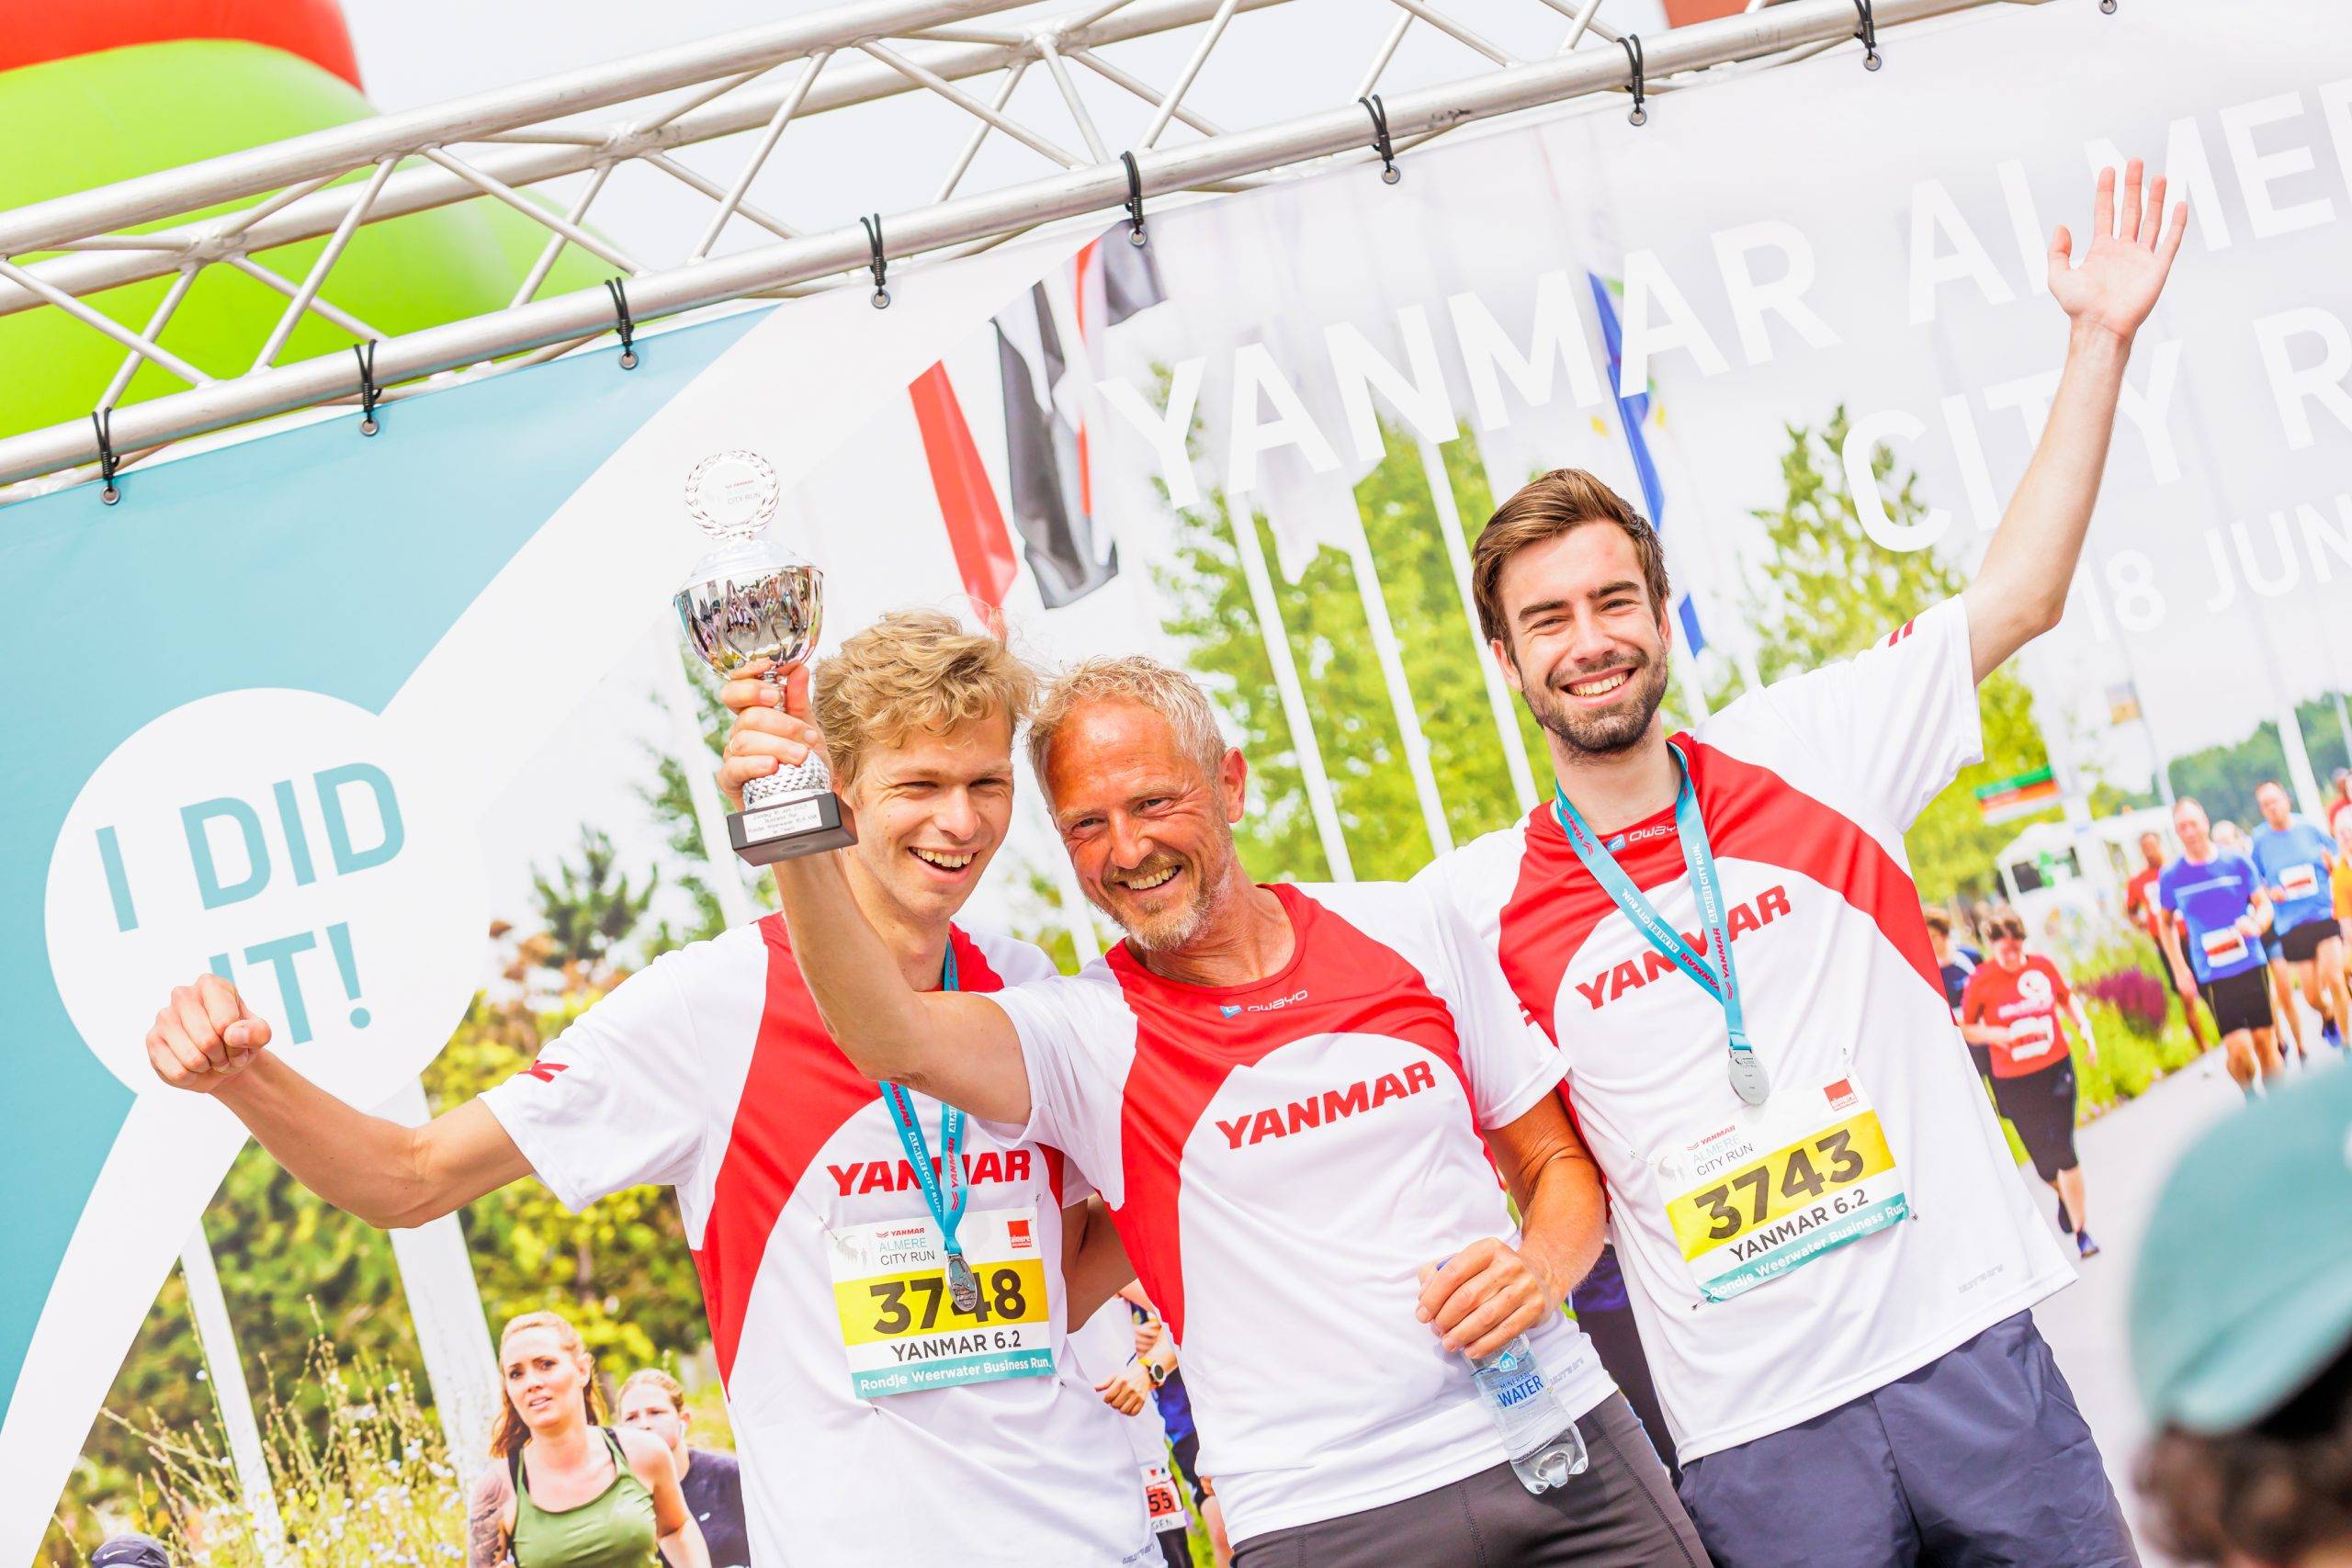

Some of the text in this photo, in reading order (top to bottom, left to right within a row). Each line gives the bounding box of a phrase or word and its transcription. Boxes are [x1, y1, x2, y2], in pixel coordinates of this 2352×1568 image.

[1096, 220, 1840, 509] YANMAR
[96, 761, 405, 932] I DID
[1713, 928, 1729, 978] YANMAR
[1215, 1060, 1436, 1149] YANMAR
[1693, 1134, 1741, 1164] ALMERE
[1701, 1125, 1736, 1145] YANMAR
[948, 1136, 958, 1189] YANMAR
[1697, 1143, 1754, 1176] CITY RUN
[1694, 1129, 1864, 1240] 3743
[891, 1227, 925, 1237] YANMAR
[1729, 1188, 1869, 1263] YANMAR 6.2
[879, 1237, 927, 1252] ALMERE
[880, 1250, 935, 1266] CITY RUN
[1755, 1237, 1826, 1278] Weerwater
[1828, 1212, 1884, 1243] Business
[890, 1329, 1022, 1362] YANMAR 6.2
[860, 1374, 908, 1392] Rondje
[911, 1365, 980, 1382] Weerwater
[983, 1359, 1029, 1373] Business
[1498, 1375, 1544, 1407] WATER
